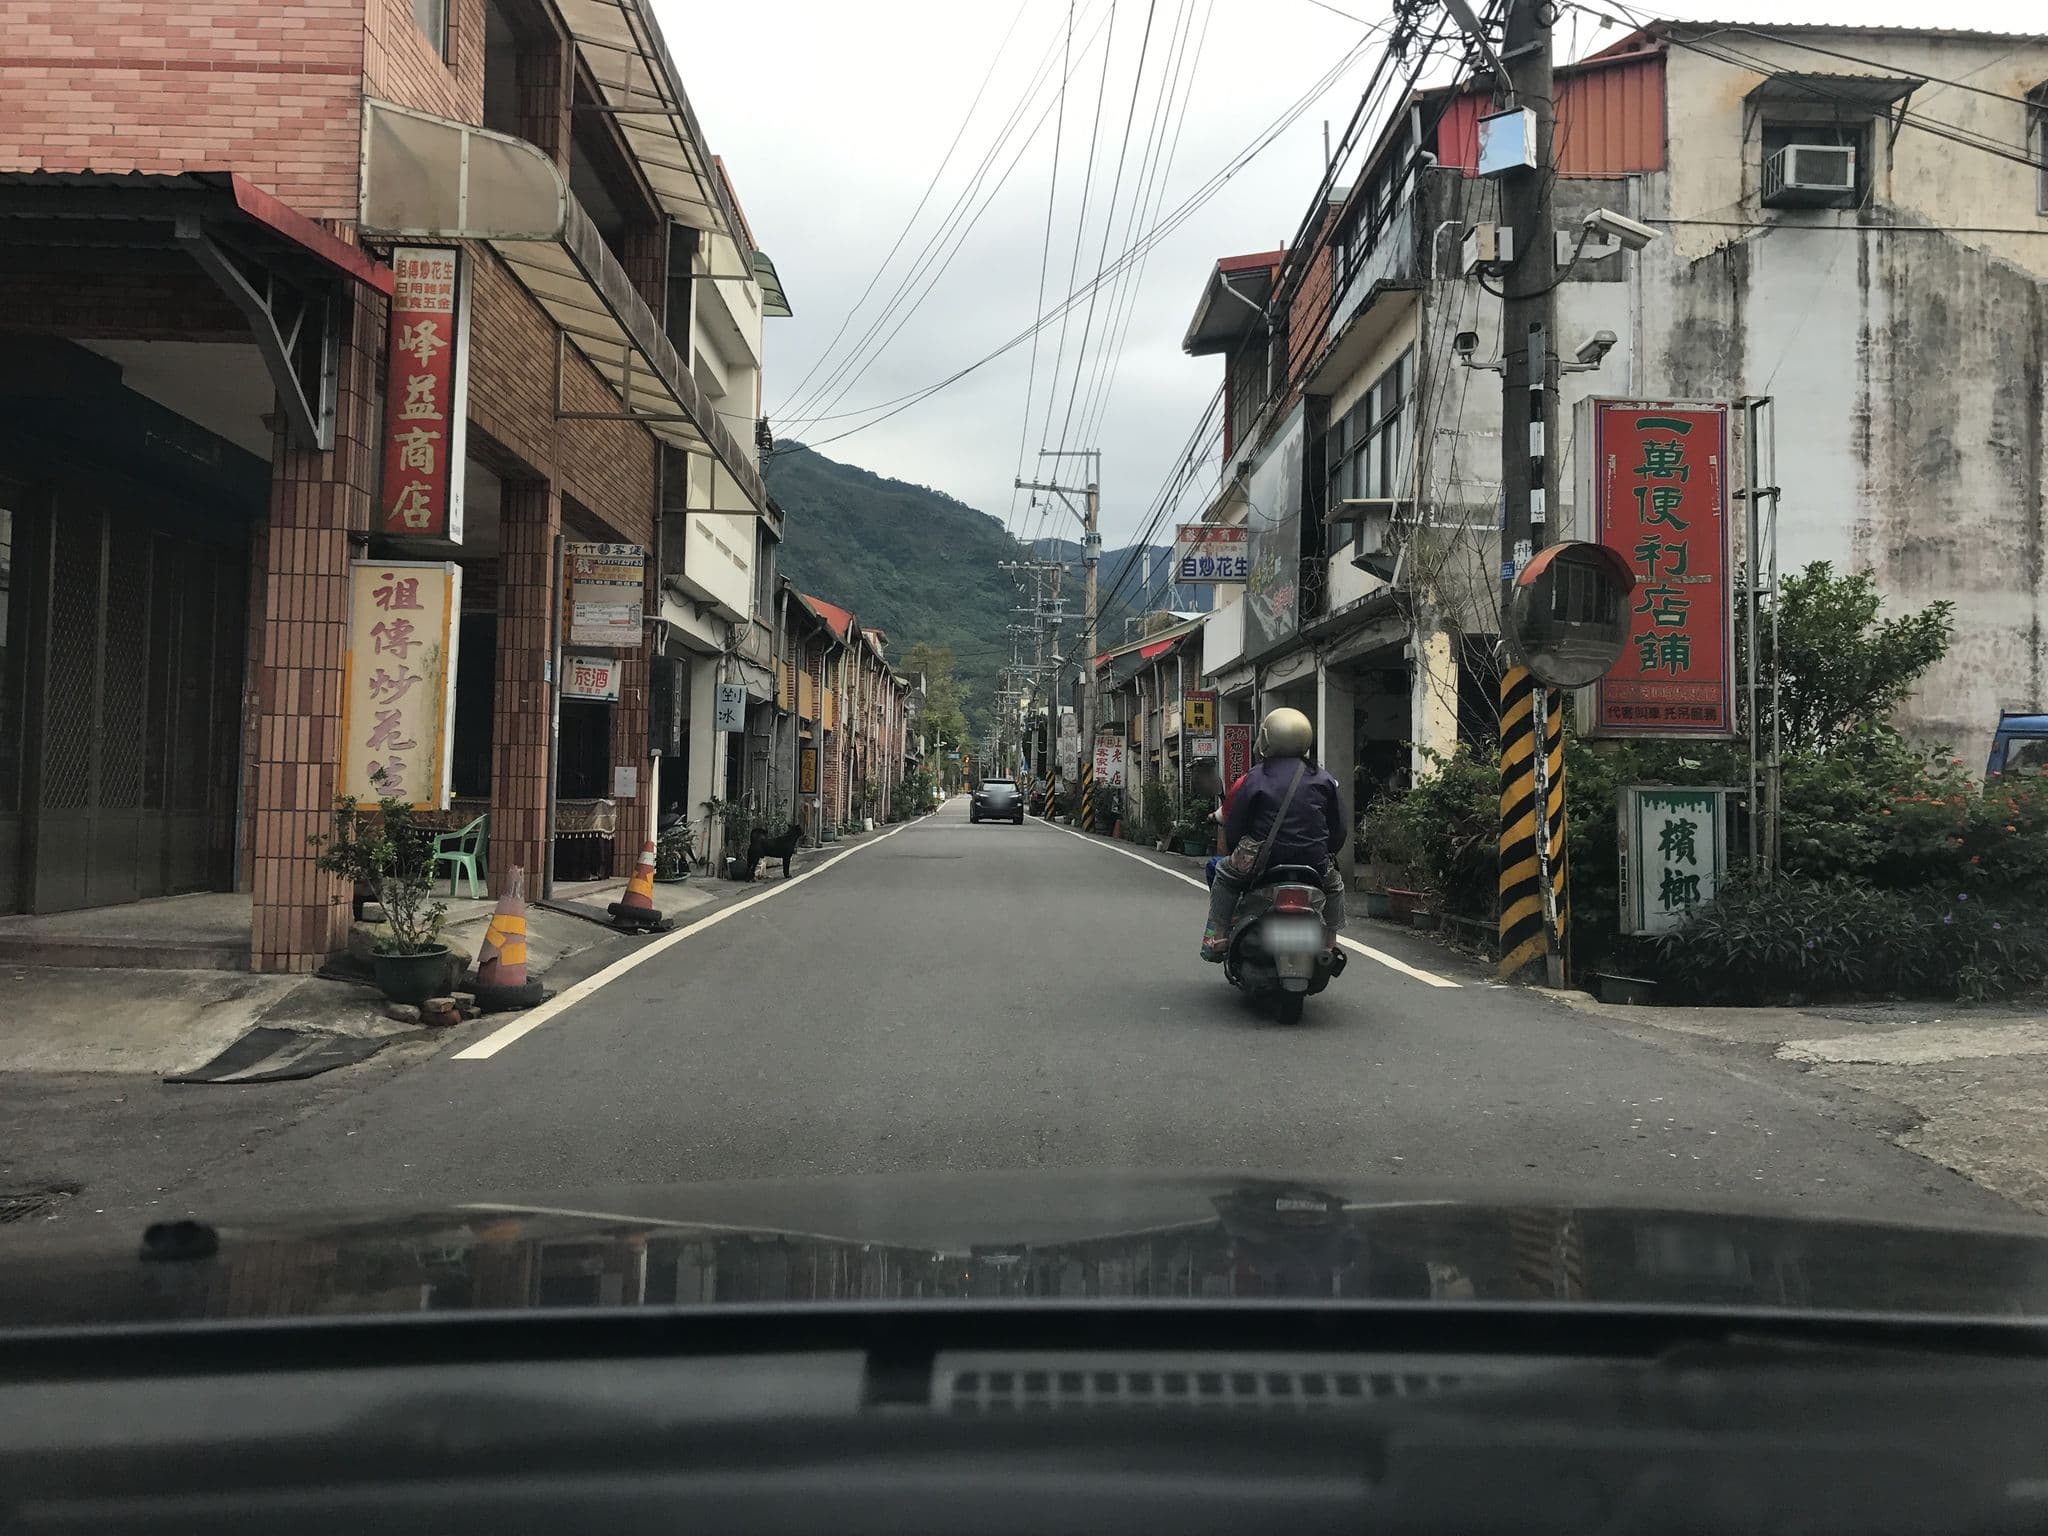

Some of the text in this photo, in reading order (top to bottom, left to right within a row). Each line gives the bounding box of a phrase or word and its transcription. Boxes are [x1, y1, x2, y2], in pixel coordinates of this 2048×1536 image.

[397, 257, 453, 280] 祖傳炒花生
[387, 319, 448, 529] 峰益商店
[1182, 556, 1248, 577] 自炒花生
[365, 572, 425, 797] 祖傳炒花生
[574, 667, 610, 689] 菸酒
[1657, 817, 1701, 919] 檳榔
